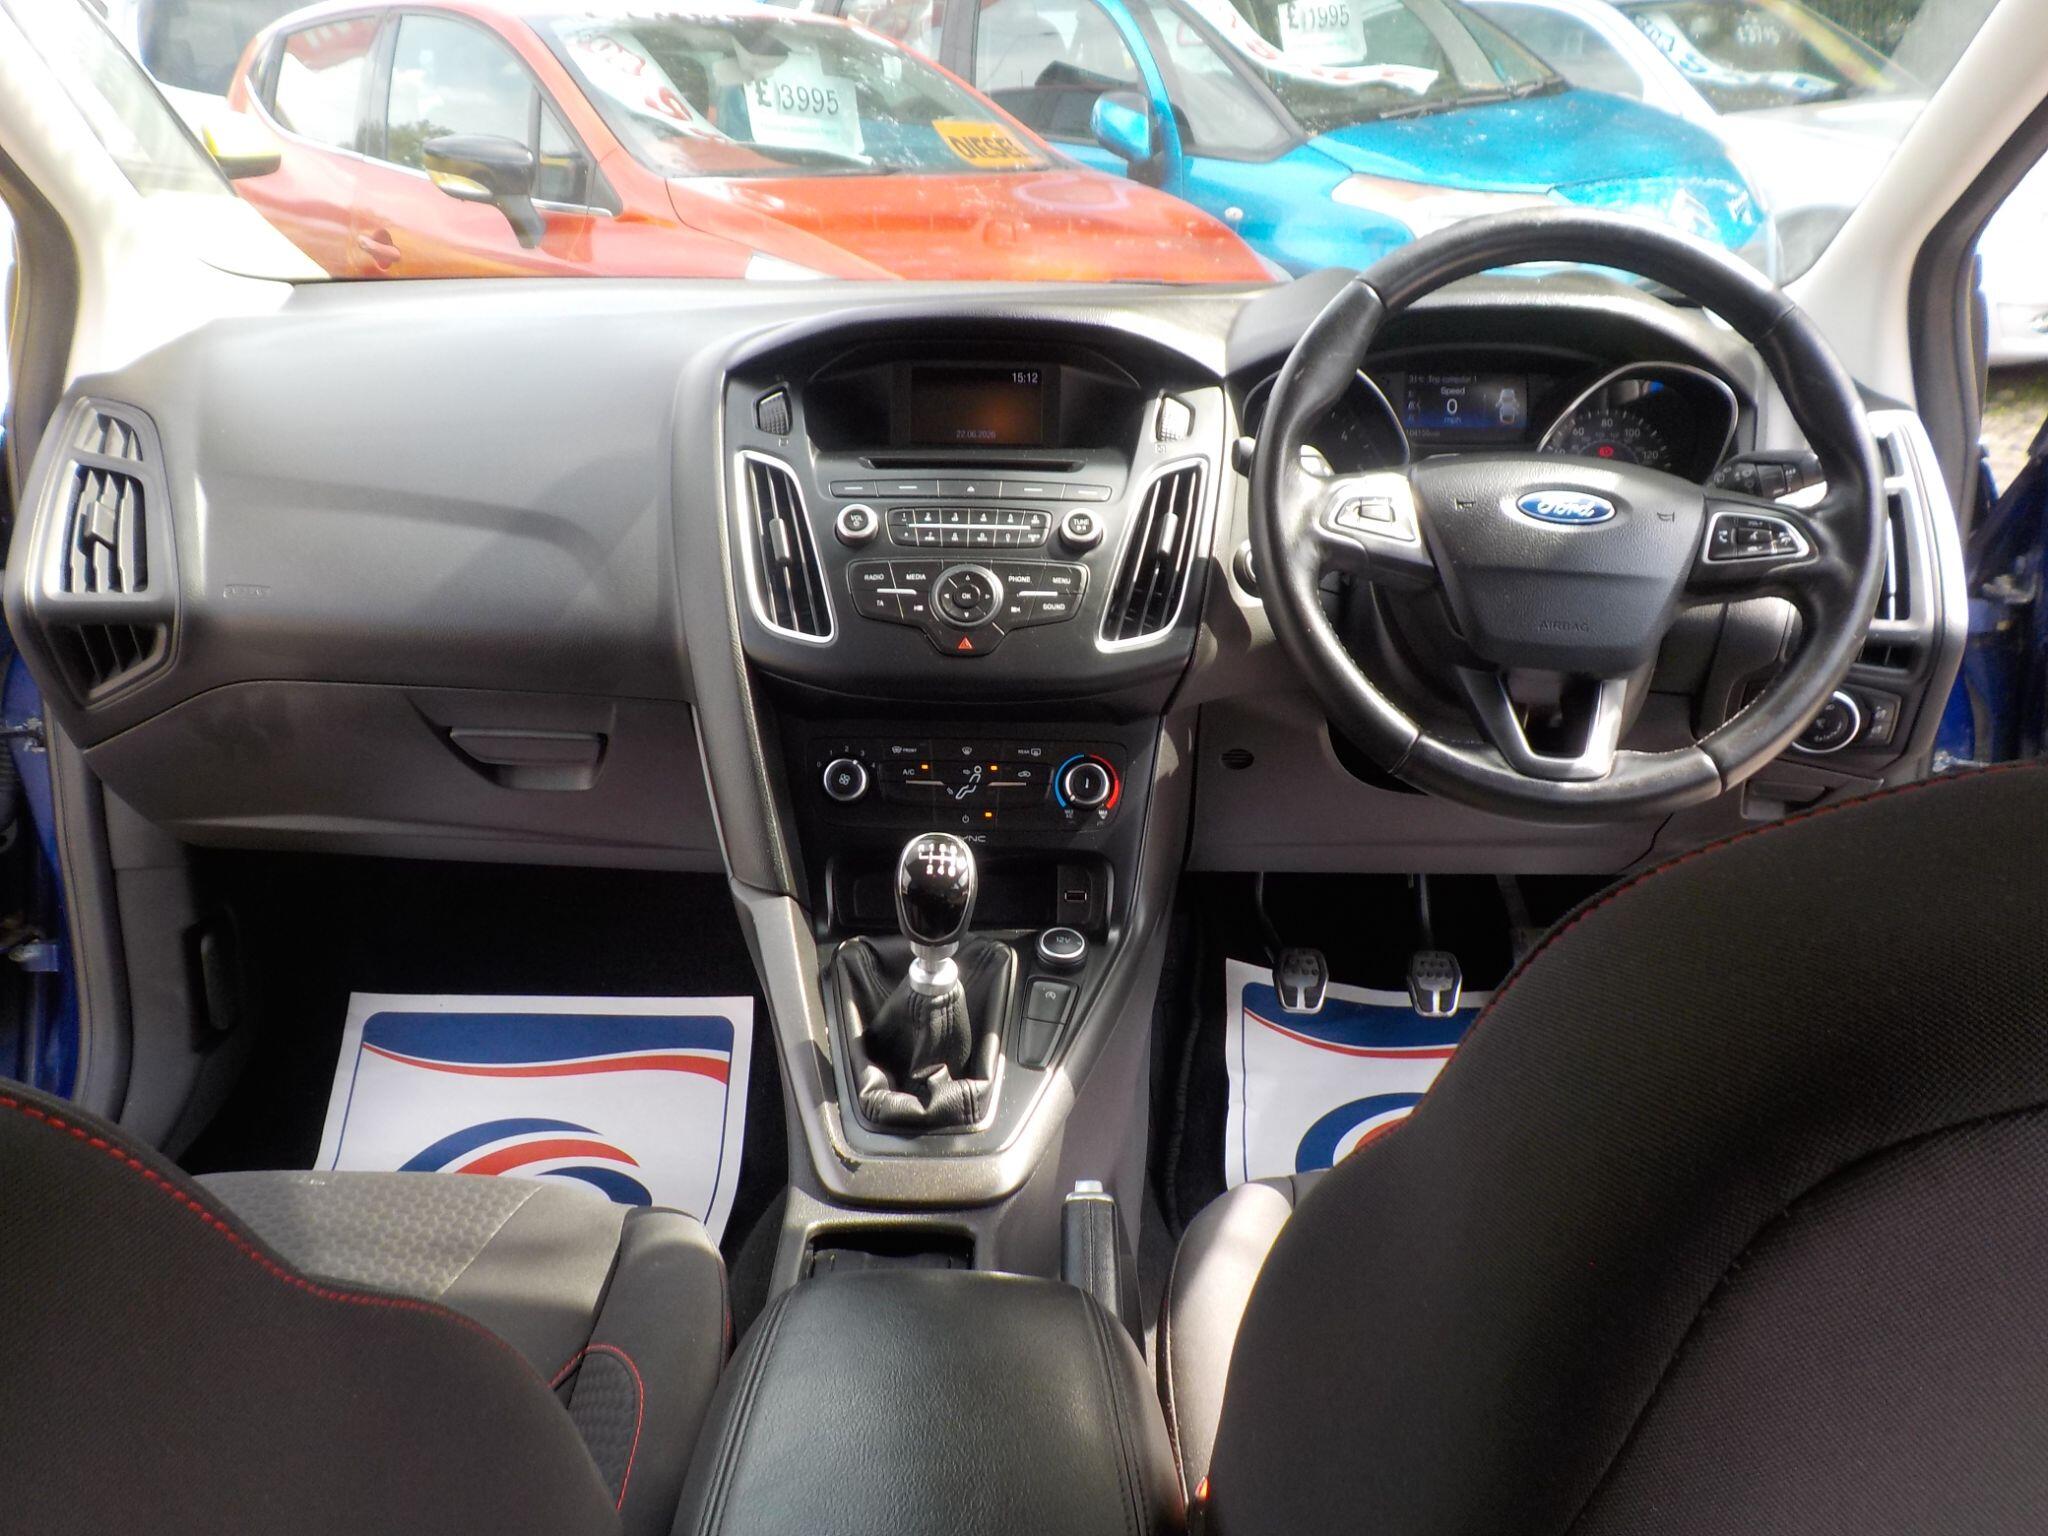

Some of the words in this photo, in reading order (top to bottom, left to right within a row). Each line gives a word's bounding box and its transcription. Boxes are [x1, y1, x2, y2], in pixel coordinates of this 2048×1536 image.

[1012, 372, 1038, 383] 15:12
[1440, 387, 1466, 396] Speed
[1446, 398, 1458, 415] 0
[1624, 428, 1640, 437] 100
[1008, 575, 1031, 583] PHONE
